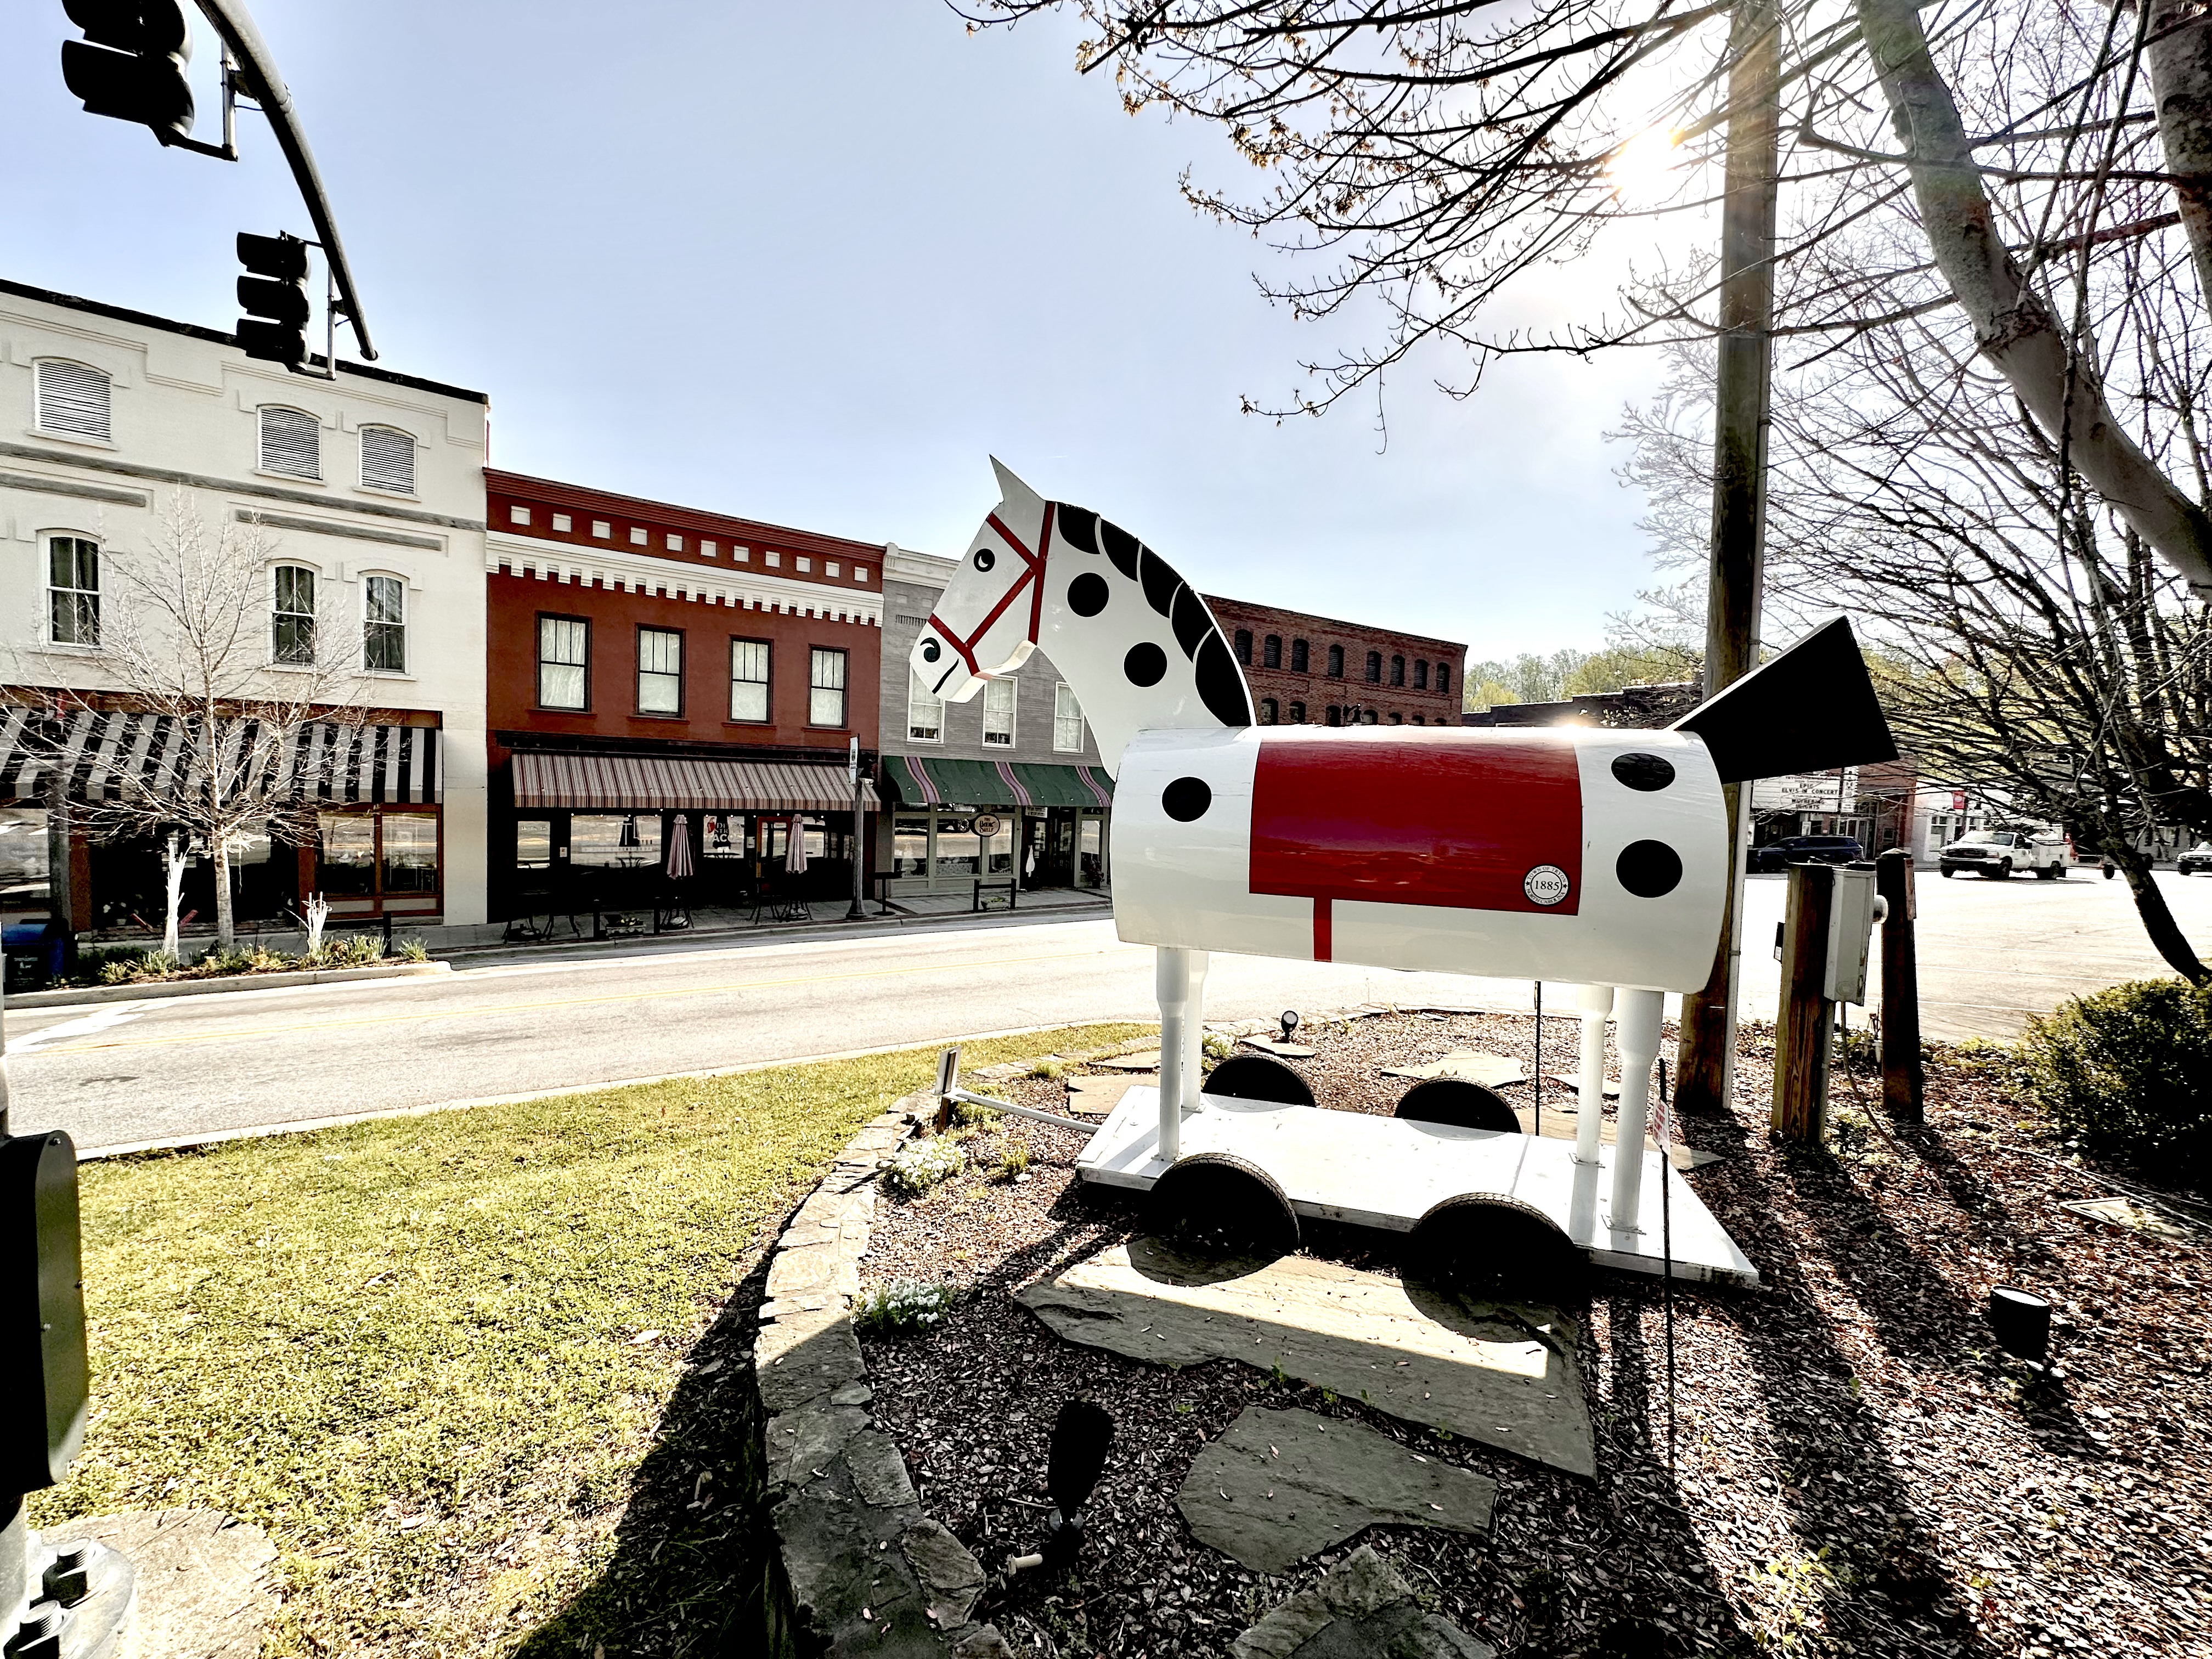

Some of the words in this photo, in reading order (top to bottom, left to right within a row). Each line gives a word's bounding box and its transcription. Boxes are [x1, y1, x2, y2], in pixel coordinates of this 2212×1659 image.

[1527, 867, 1542, 881] TOWN
[1551, 867, 1567, 883] TRYON
[1535, 881, 1560, 890] 1885
[1526, 888, 1541, 902] NORTH
[1540, 891, 1566, 904] CAROLINA
